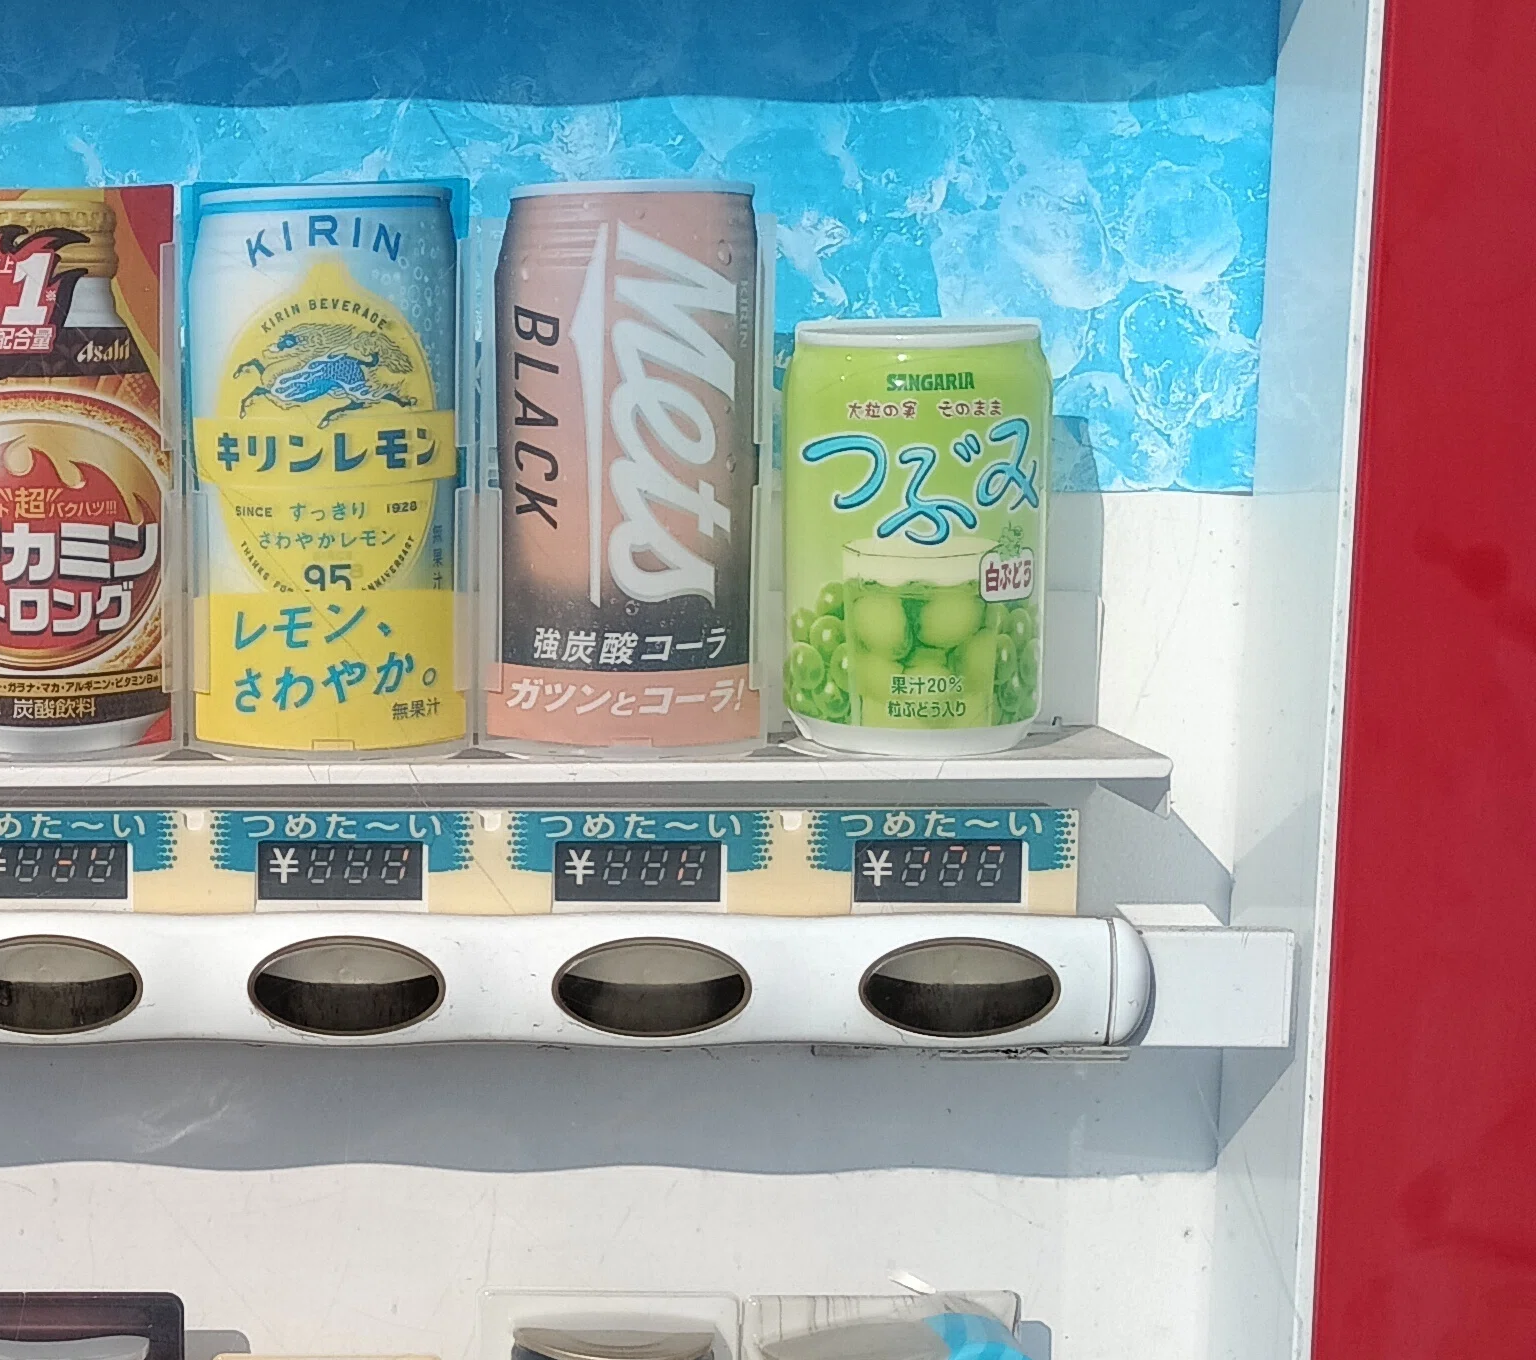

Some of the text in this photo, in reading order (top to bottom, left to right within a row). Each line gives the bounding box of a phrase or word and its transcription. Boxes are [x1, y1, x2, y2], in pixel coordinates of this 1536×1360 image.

[246, 214, 402, 268] KIRIN
[308, 298, 388, 330] BEVERAGE
[886, 371, 975, 392] SANGARIA
[513, 305, 560, 530] BLACK
[610, 218, 739, 608] Mets
[848, 400, 1003, 419] 大粒の実 そのまま
[216, 429, 437, 474] キリンレモン
[235, 504, 366, 521] SINCE すっきり
[259, 529, 396, 550] さわやかレモン
[985, 558, 1033, 594] 白ぶどう
[532, 627, 729, 667] 強炭酸コーラ
[890, 675, 964, 695] 果汁20%
[887, 698, 967, 719] 粒ぶどう入り
